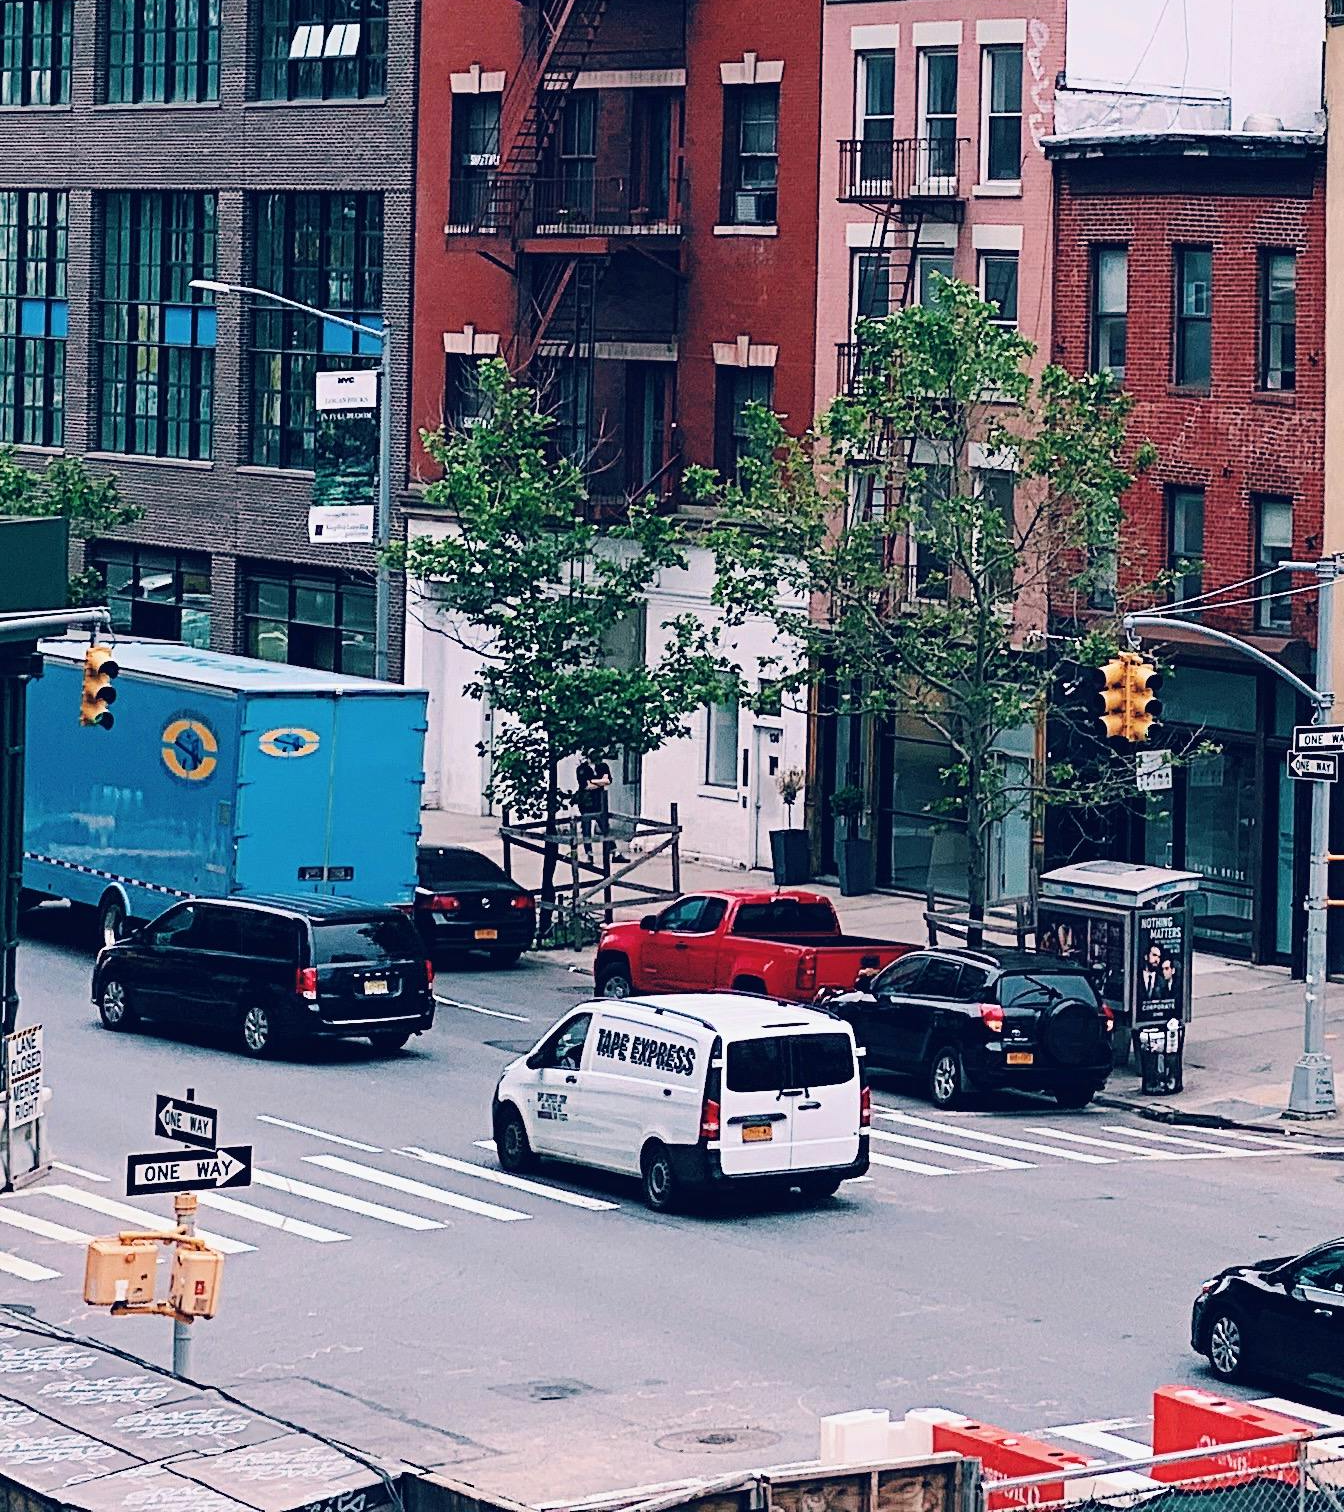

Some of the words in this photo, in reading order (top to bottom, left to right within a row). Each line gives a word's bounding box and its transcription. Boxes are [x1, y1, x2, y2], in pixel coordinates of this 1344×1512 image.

[1304, 734, 1324, 745] ONE
[1295, 760, 1310, 772] ONE
[1316, 762, 1331, 773] WAY
[1221, 867, 1245, 880] BRIDE
[1141, 917, 1173, 929] NOTHING
[1150, 926, 1181, 939] MATTERS
[16, 1032, 36, 1055] LANE
[597, 1028, 628, 1062] TAPE
[630, 1037, 696, 1076] EXPRESS
[11, 1050, 41, 1076] CLOSED
[12, 1077, 40, 1101] MERGE
[15, 1097, 38, 1120] RIGHT
[164, 1110, 182, 1129] ONE
[189, 1117, 209, 1134] WAY
[144, 1164, 180, 1182] ONE
[197, 1160, 233, 1178] WAY
